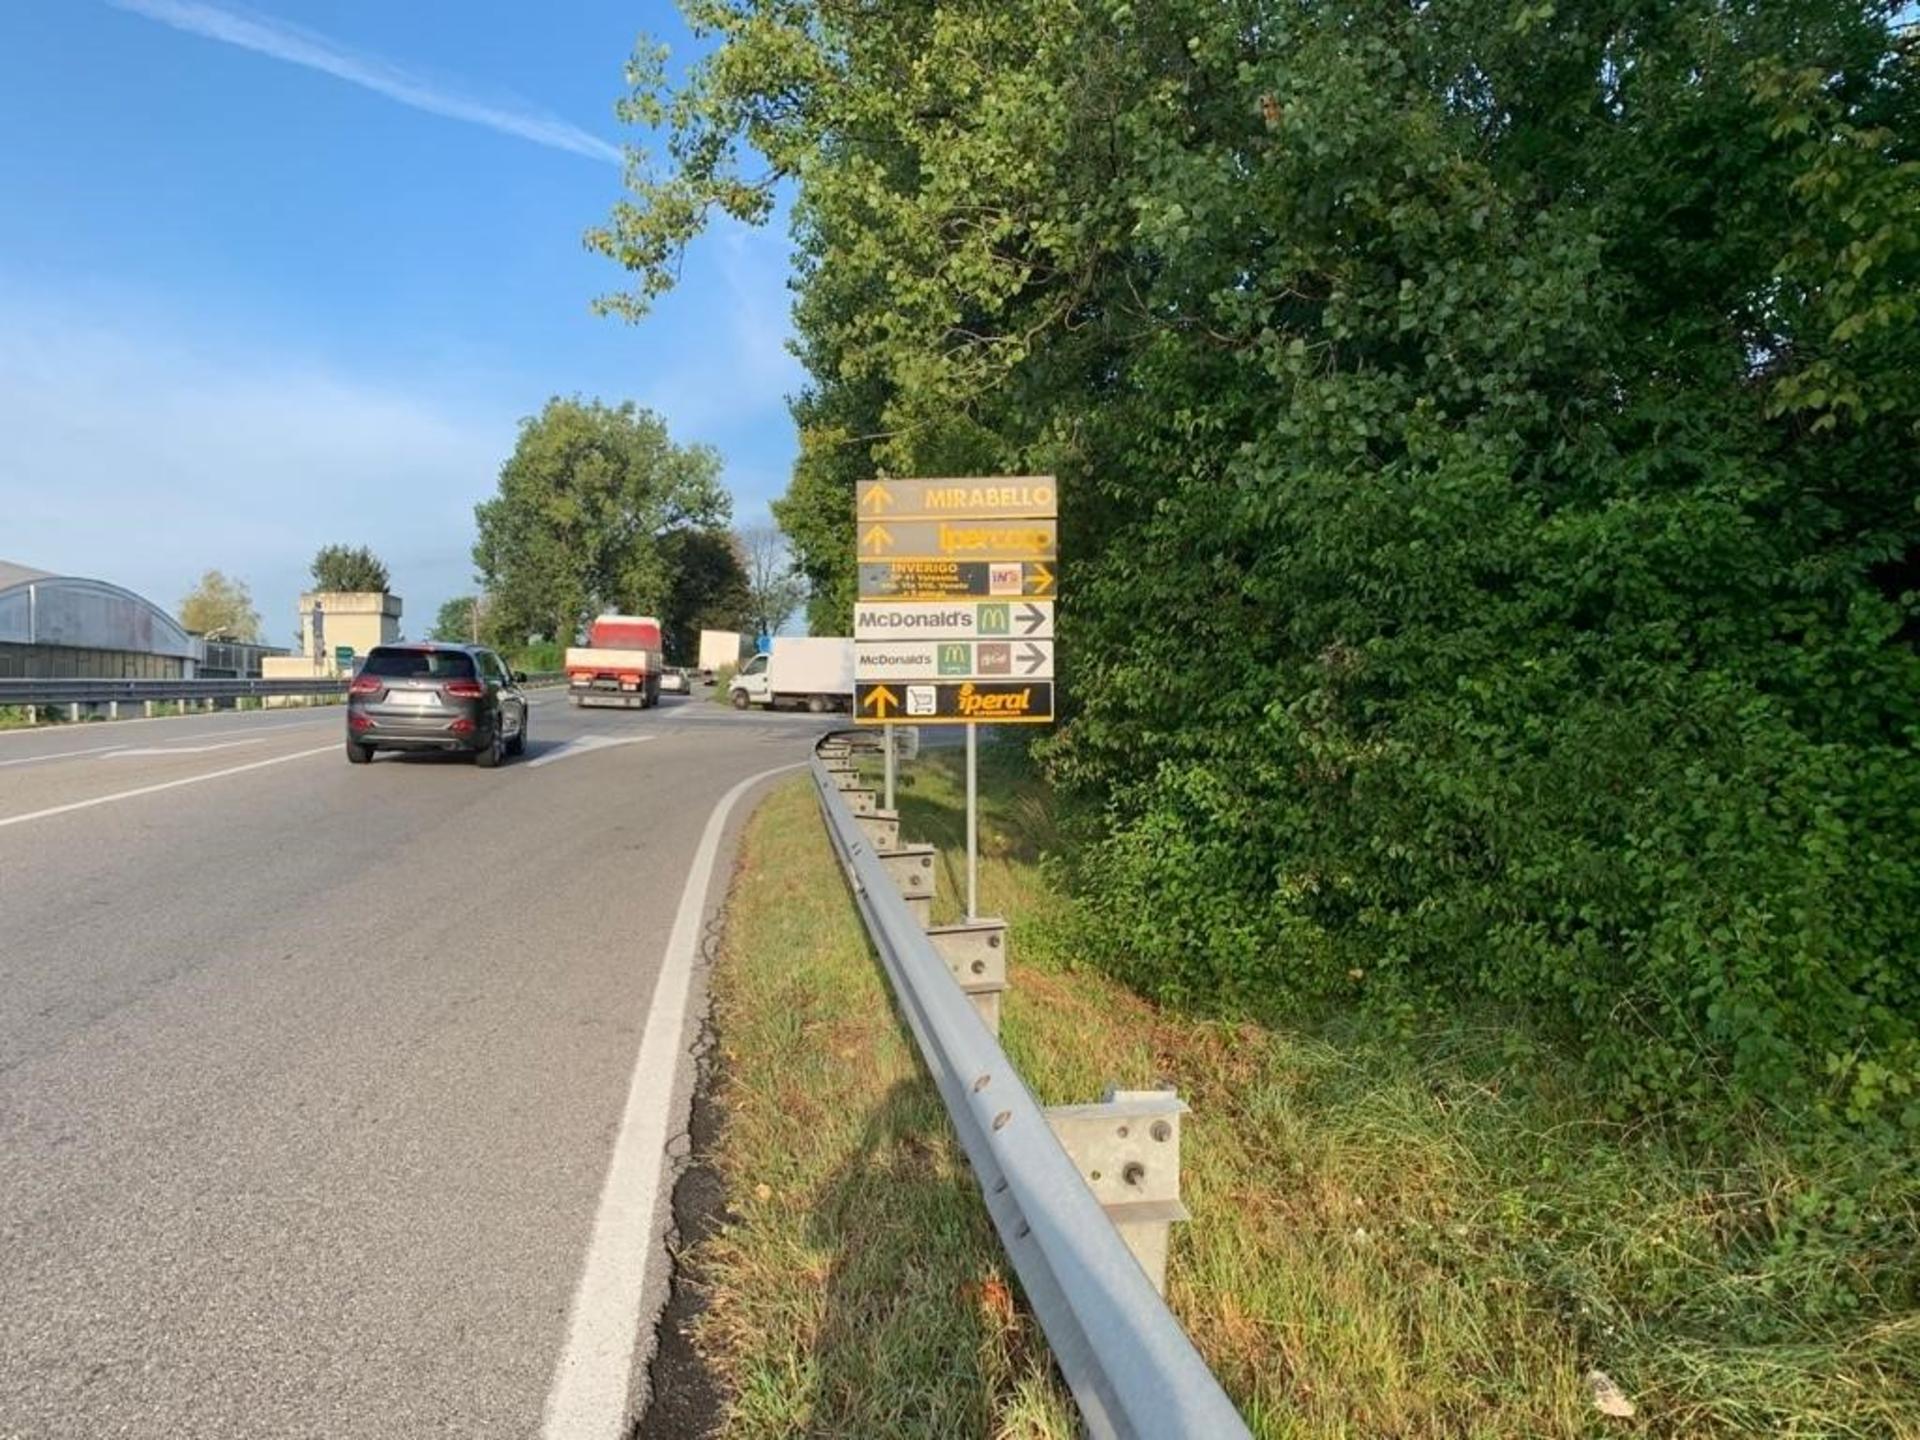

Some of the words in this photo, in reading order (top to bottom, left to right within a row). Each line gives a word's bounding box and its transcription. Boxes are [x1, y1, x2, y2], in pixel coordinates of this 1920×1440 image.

[925, 486, 1052, 508] MIRABELLO
[890, 563, 959, 574] INVERIGO
[858, 611, 973, 628] McDonald's
[859, 654, 932, 666] McDonald's
[958, 683, 1031, 715] iperal
